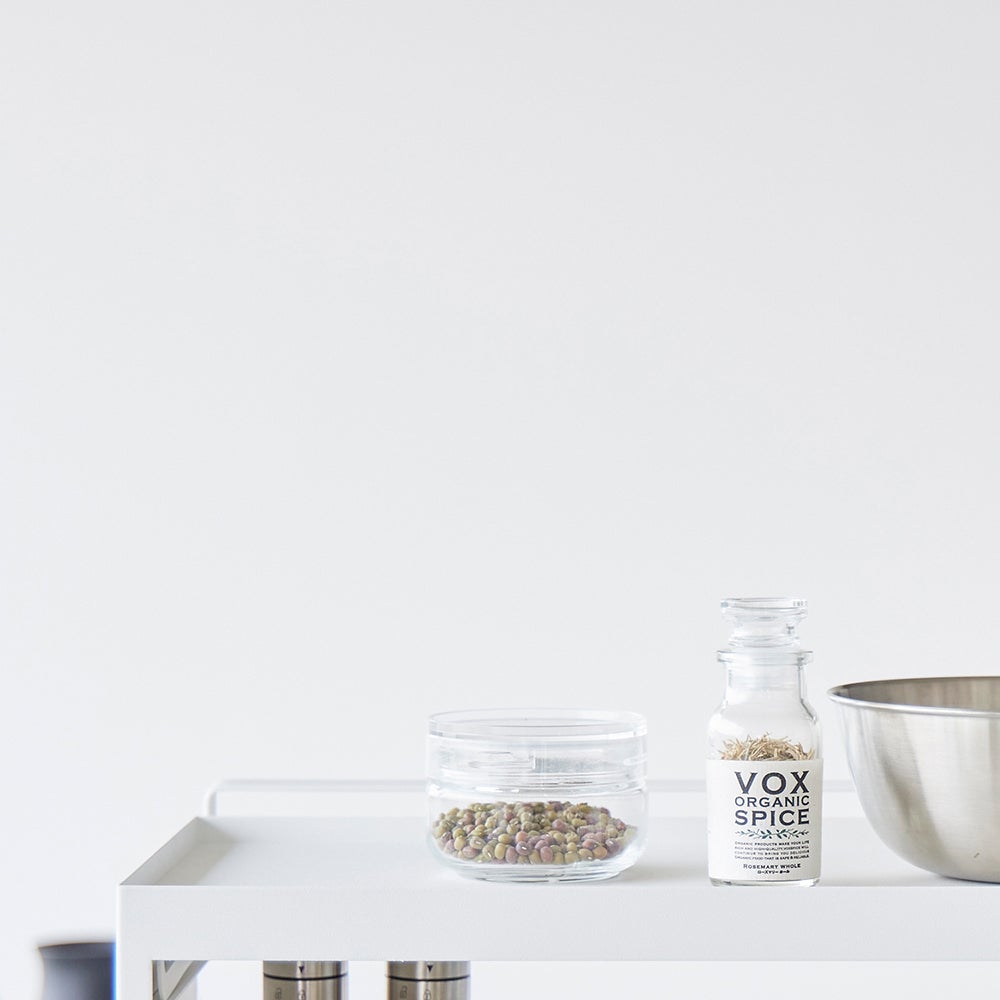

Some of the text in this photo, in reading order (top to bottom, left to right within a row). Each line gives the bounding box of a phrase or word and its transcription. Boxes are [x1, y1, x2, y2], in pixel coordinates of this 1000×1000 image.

[734, 770, 809, 795] VOX
[735, 795, 809, 807] ORGANIC
[734, 808, 809, 826] SPICE
